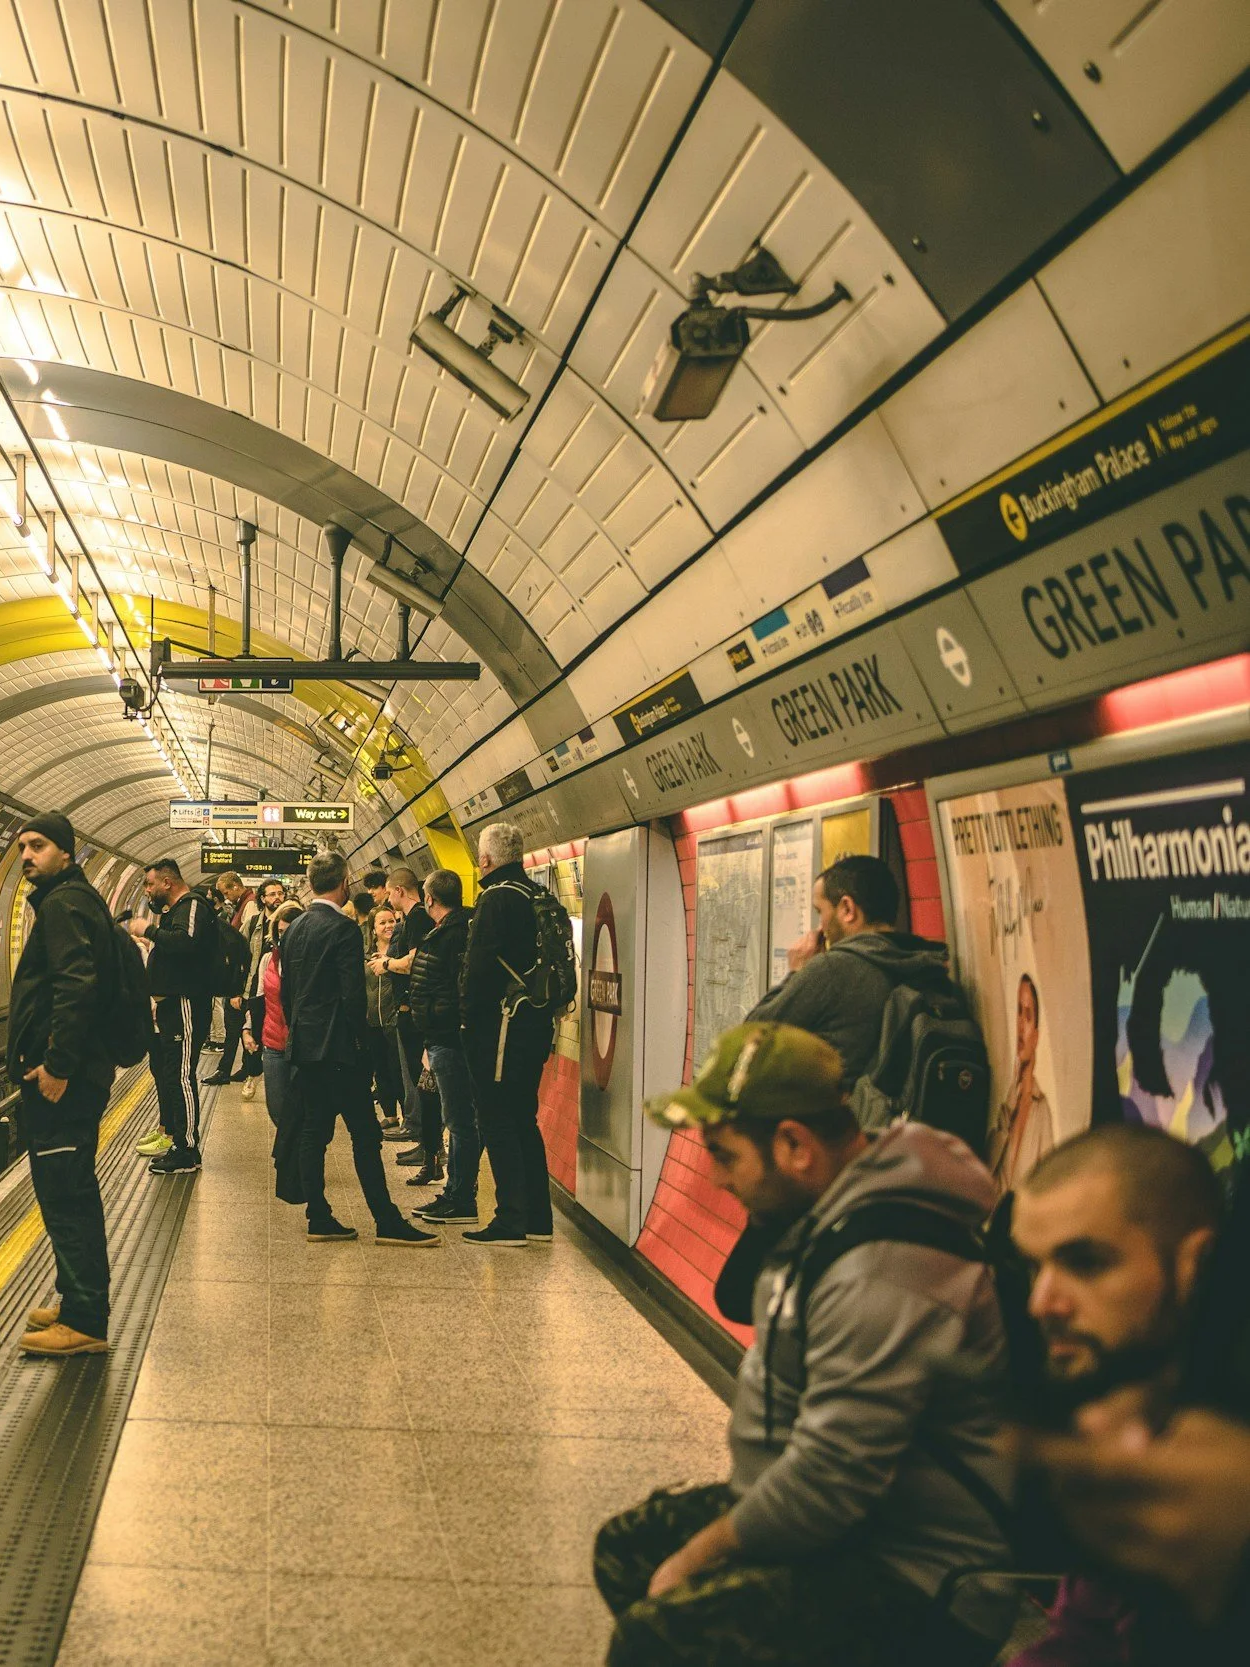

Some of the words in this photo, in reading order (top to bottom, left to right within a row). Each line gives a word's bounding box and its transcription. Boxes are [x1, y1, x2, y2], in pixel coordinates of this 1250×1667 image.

[1019, 466, 1102, 523] Buckingham
[1094, 440, 1151, 485] Palace
[1020, 537, 1179, 660] GREEN
[770, 678, 843, 747] GREEN
[828, 653, 903, 727] PARK
[645, 748, 691, 793] GREEN
[677, 732, 722, 784] PARK
[295, 809, 319, 821] Way
[319, 809, 337, 819] out
[952, 803, 1063, 856] PRETTYLITTLETHING
[1084, 803, 1250, 883] Philharmonia
[590, 979, 606, 1003] GREEN
[606, 980, 619, 1006] PARK
